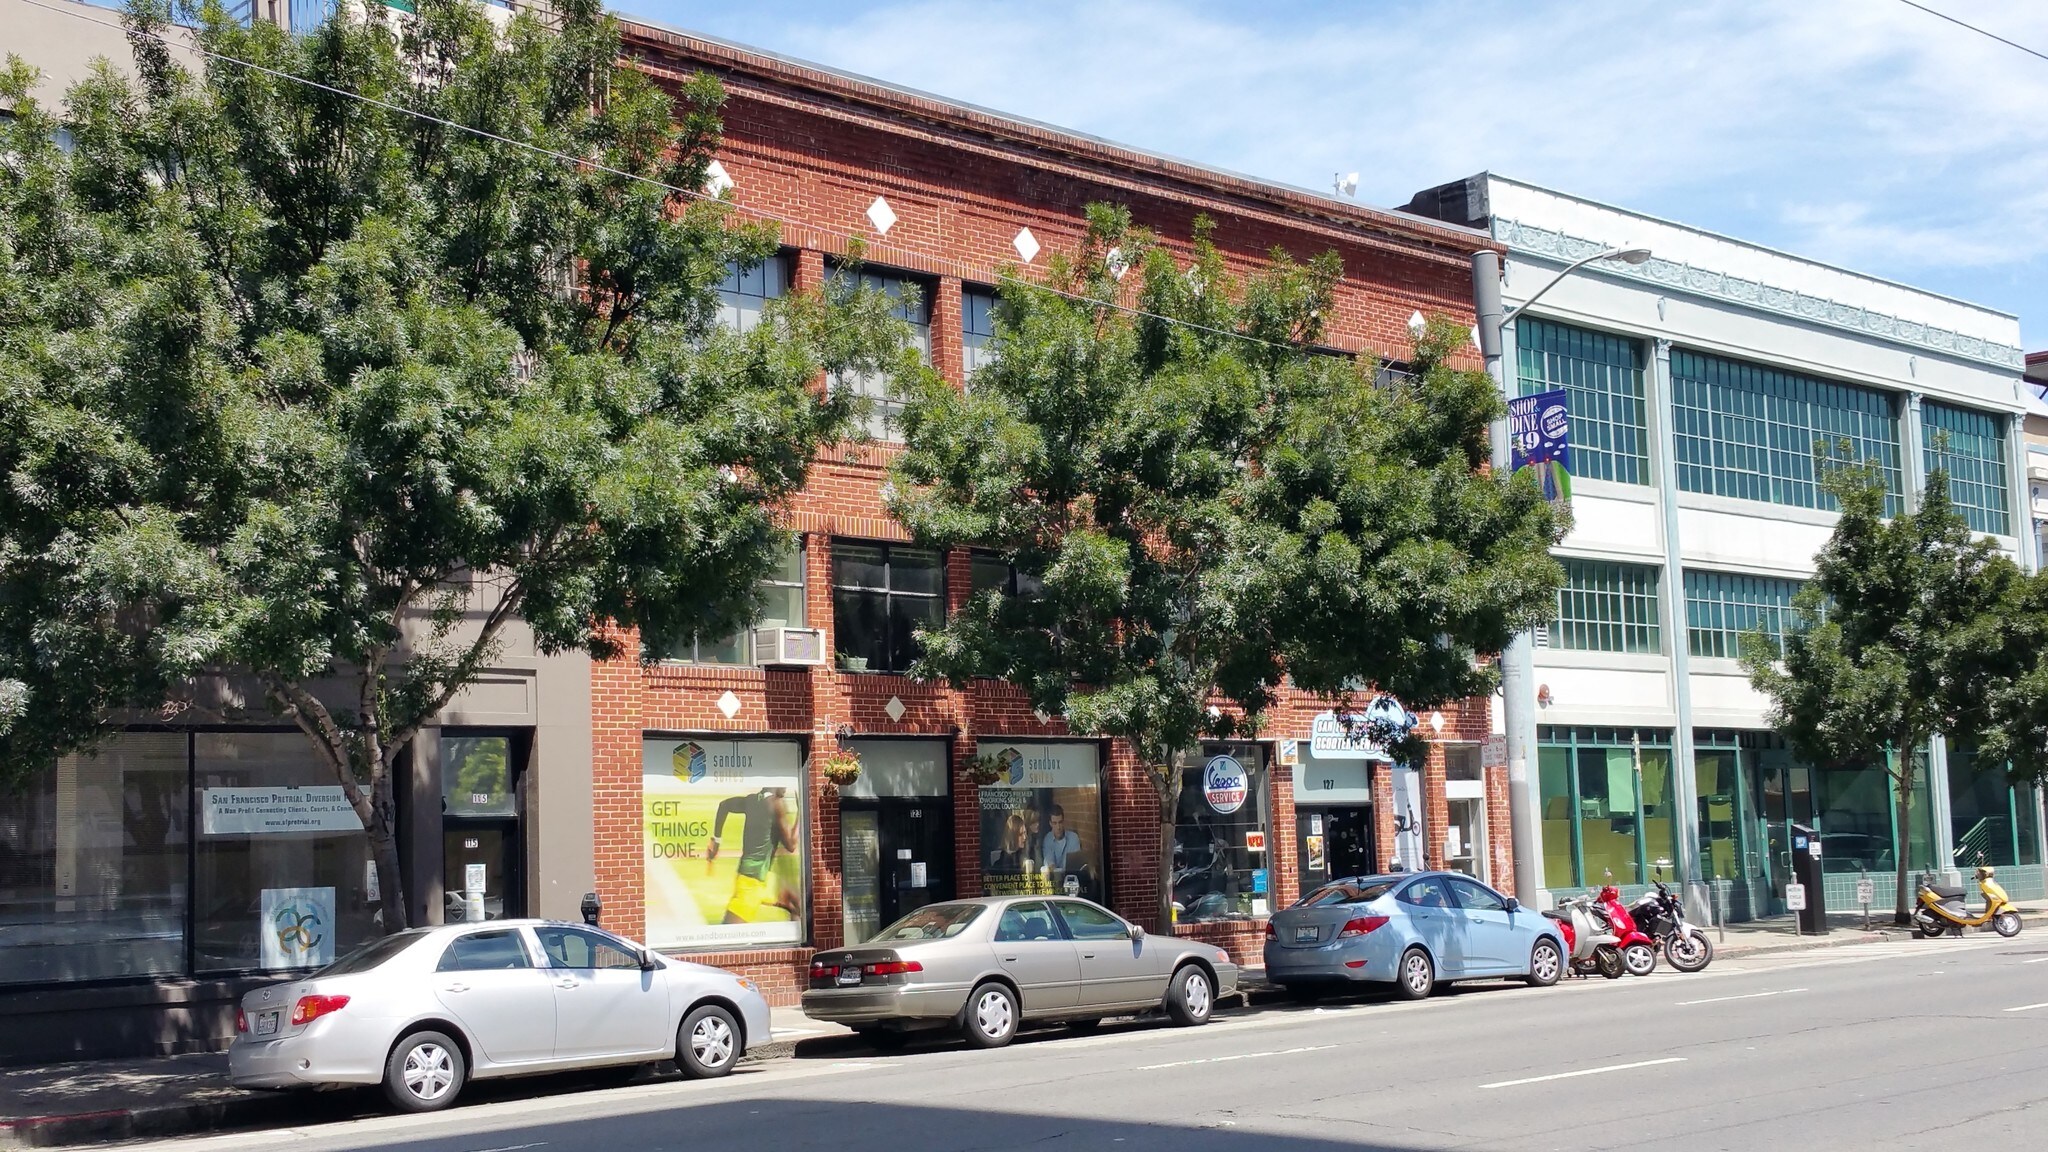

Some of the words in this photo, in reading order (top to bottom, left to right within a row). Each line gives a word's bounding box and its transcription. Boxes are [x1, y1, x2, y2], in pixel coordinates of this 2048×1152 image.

[1511, 398, 1537, 416] SHOP
[1511, 414, 1538, 434] DINE
[1512, 432, 1540, 450] 49
[1318, 720, 1334, 733] SAN
[1316, 736, 1351, 750] SCOOTER
[713, 741, 752, 768] sandbox
[1028, 746, 1060, 770] sandbox
[714, 770, 744, 783] suites
[1030, 772, 1054, 783] suites
[1208, 766, 1242, 790] Vespa
[1323, 780, 1334, 790] 127
[212, 794, 228, 804] SAN
[231, 794, 269, 804] FRANCISCO
[272, 794, 303, 804] PRETRIAL
[306, 793, 341, 803] DIVERSION
[1212, 791, 1240, 804] SERVICE
[256, 807, 287, 815] Connecting
[652, 801, 680, 816] GET
[265, 819, 321, 827] www.sfpretrial.org
[652, 821, 708, 837] THINGS
[466, 838, 478, 848] 115
[653, 843, 700, 858] DONE.
[676, 930, 766, 941] www.sandboxsuites.com
